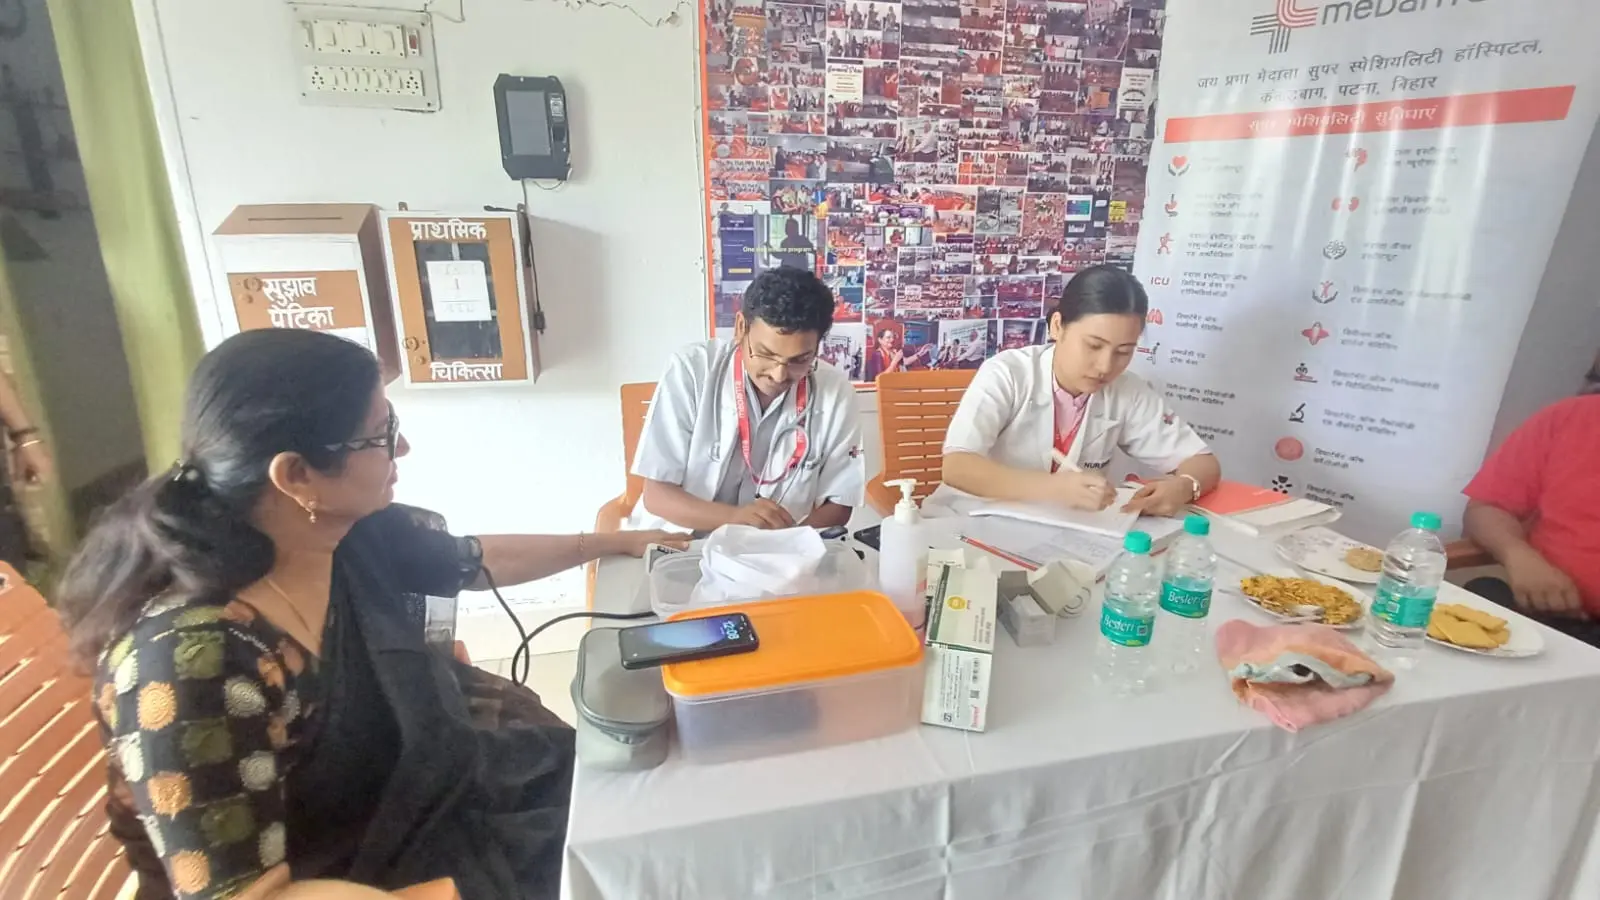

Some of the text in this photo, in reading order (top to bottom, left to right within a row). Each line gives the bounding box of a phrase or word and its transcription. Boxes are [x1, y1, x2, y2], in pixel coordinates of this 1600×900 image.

[1308, 62, 1340, 80] सुपर
[1348, 47, 1443, 74] स्पेशियलिटी
[261, 277, 317, 307] सुझाव
[1150, 277, 1170, 286] ICU
[430, 361, 503, 381] चिकित्सा
